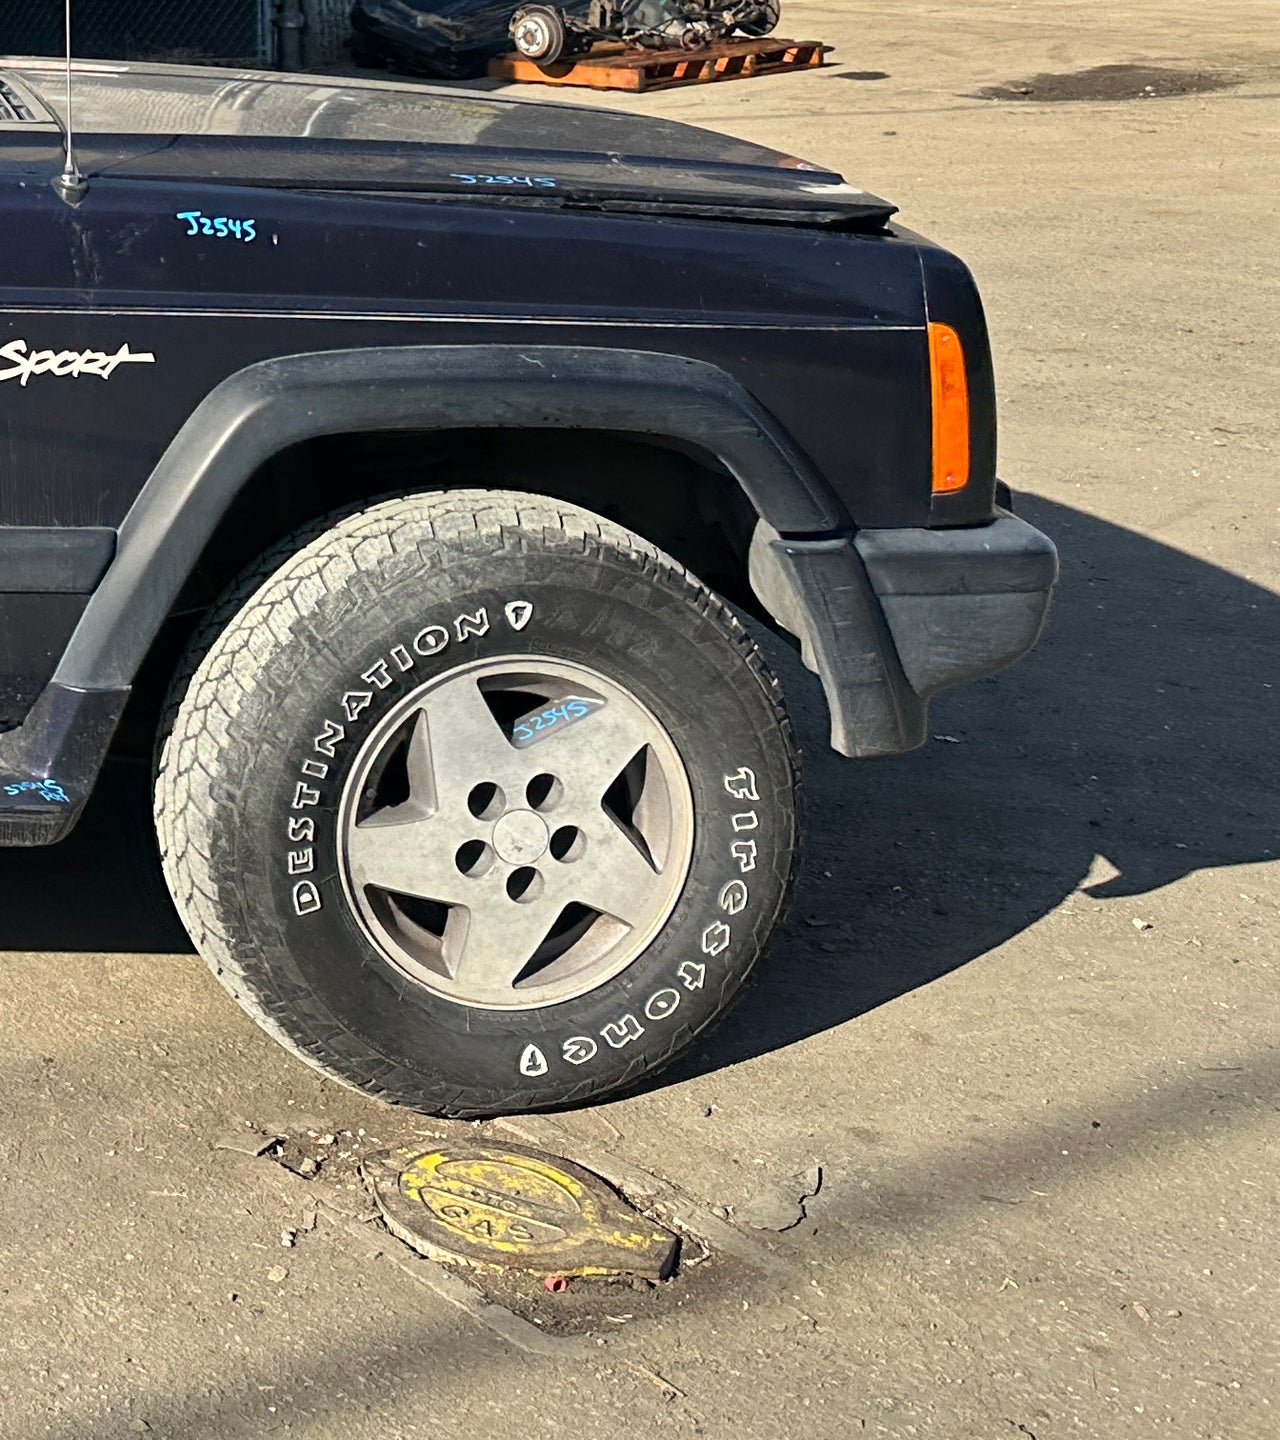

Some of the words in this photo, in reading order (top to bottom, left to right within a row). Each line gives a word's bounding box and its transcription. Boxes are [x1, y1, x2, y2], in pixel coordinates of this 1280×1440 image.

[176, 211, 257, 242] J2545
[513, 700, 589, 741] J2545
[288, 602, 491, 917] DESTINATION
[562, 766, 762, 1066] Firestone
[441, 1205, 534, 1243] GAS
